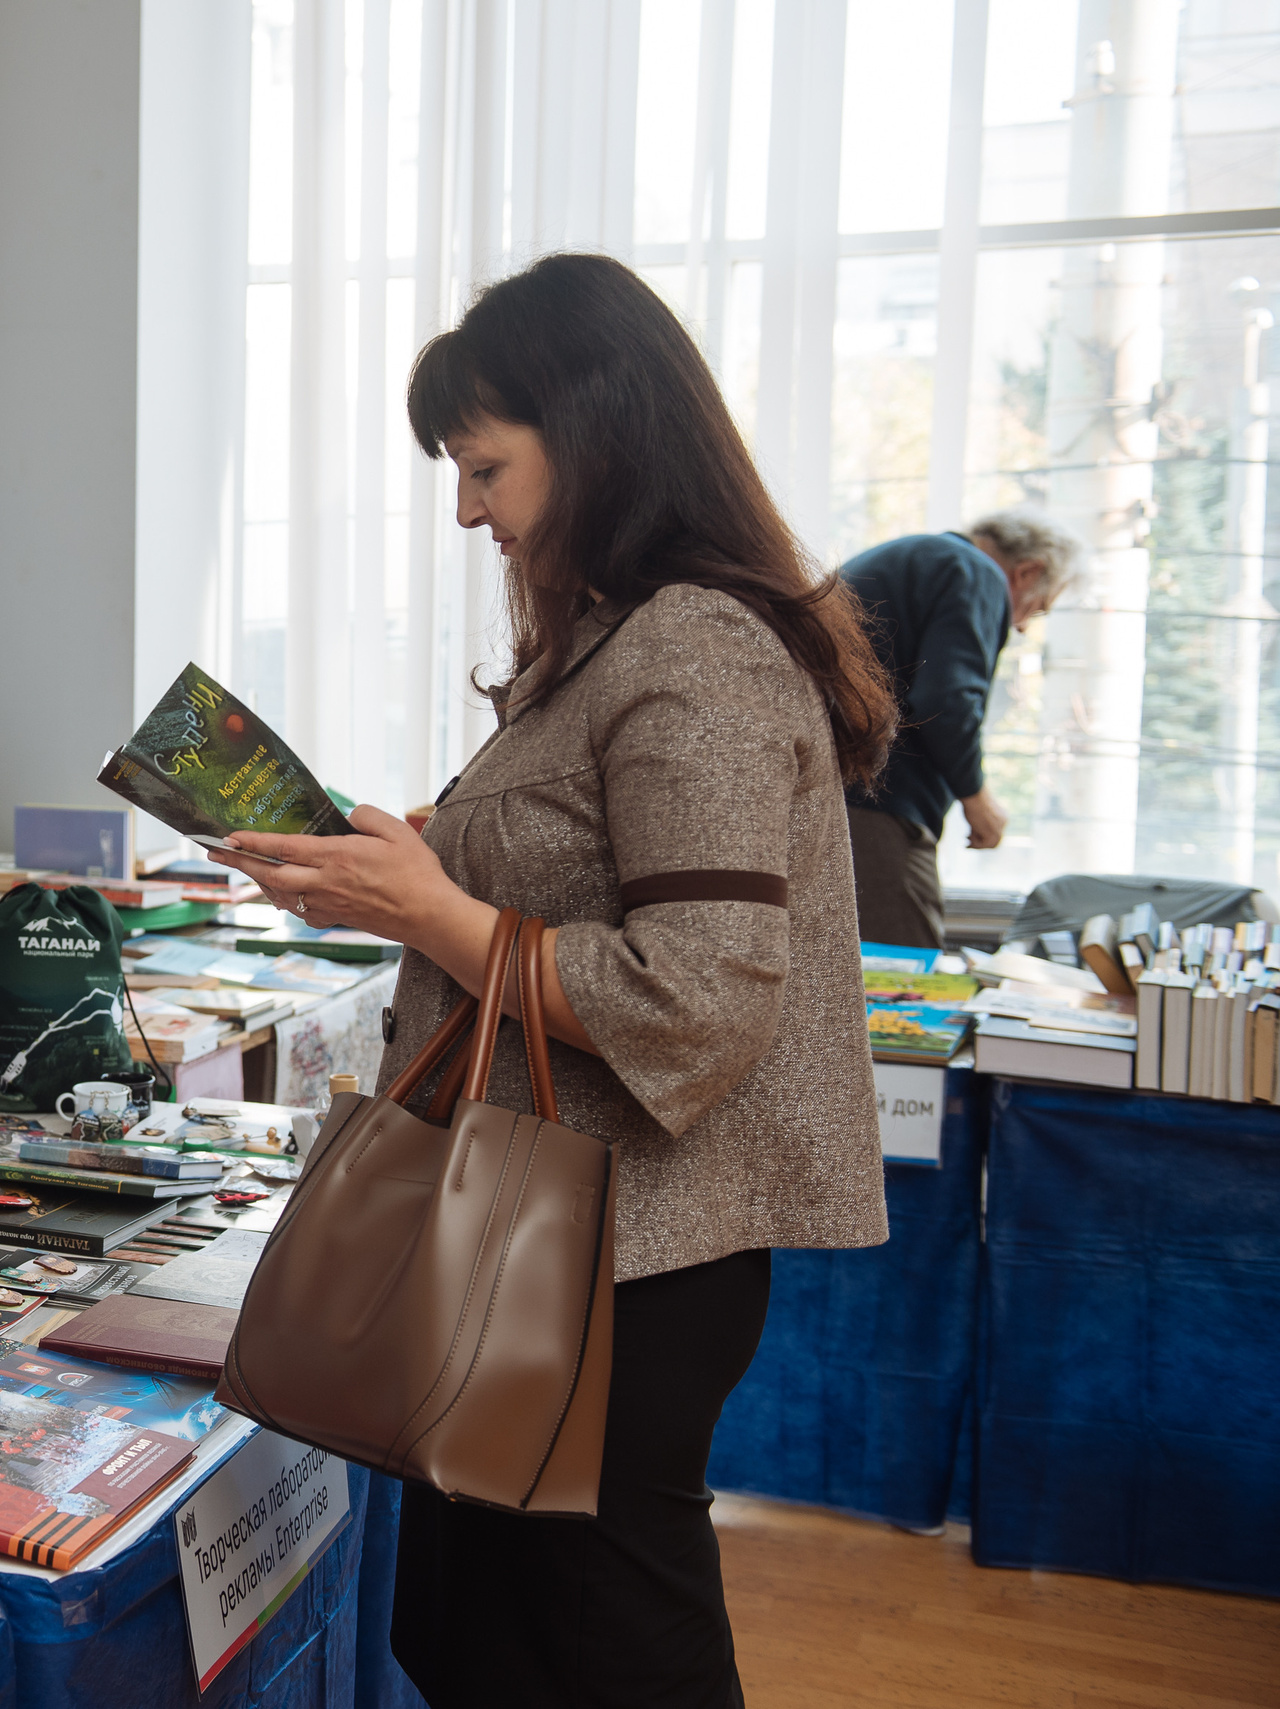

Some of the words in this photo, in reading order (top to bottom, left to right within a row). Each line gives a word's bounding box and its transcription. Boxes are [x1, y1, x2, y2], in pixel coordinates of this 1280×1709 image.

[218, 744, 268, 799] Абстрактное
[238, 758, 281, 807] творчество
[18, 936, 101, 952] ТАГАНАЙ
[23, 950, 76, 958] национальный
[77, 951, 95, 959] парк
[893, 1100, 934, 1117] ДОМ
[20, 1233, 34, 1241] гора
[37, 1234, 90, 1250] ТАГАНАЙ
[105, 1356, 165, 1371] ОБОЛЕНСКОМ
[168, 1365, 208, 1377] ЛЕОНИДЕ
[101, 1449, 131, 1477] ФРОНТ
[195, 1497, 268, 1584] Творческая
[269, 1446, 330, 1516] лаборатор
[219, 1544, 276, 1628] рекламы
[276, 1486, 329, 1561] Enterprise
